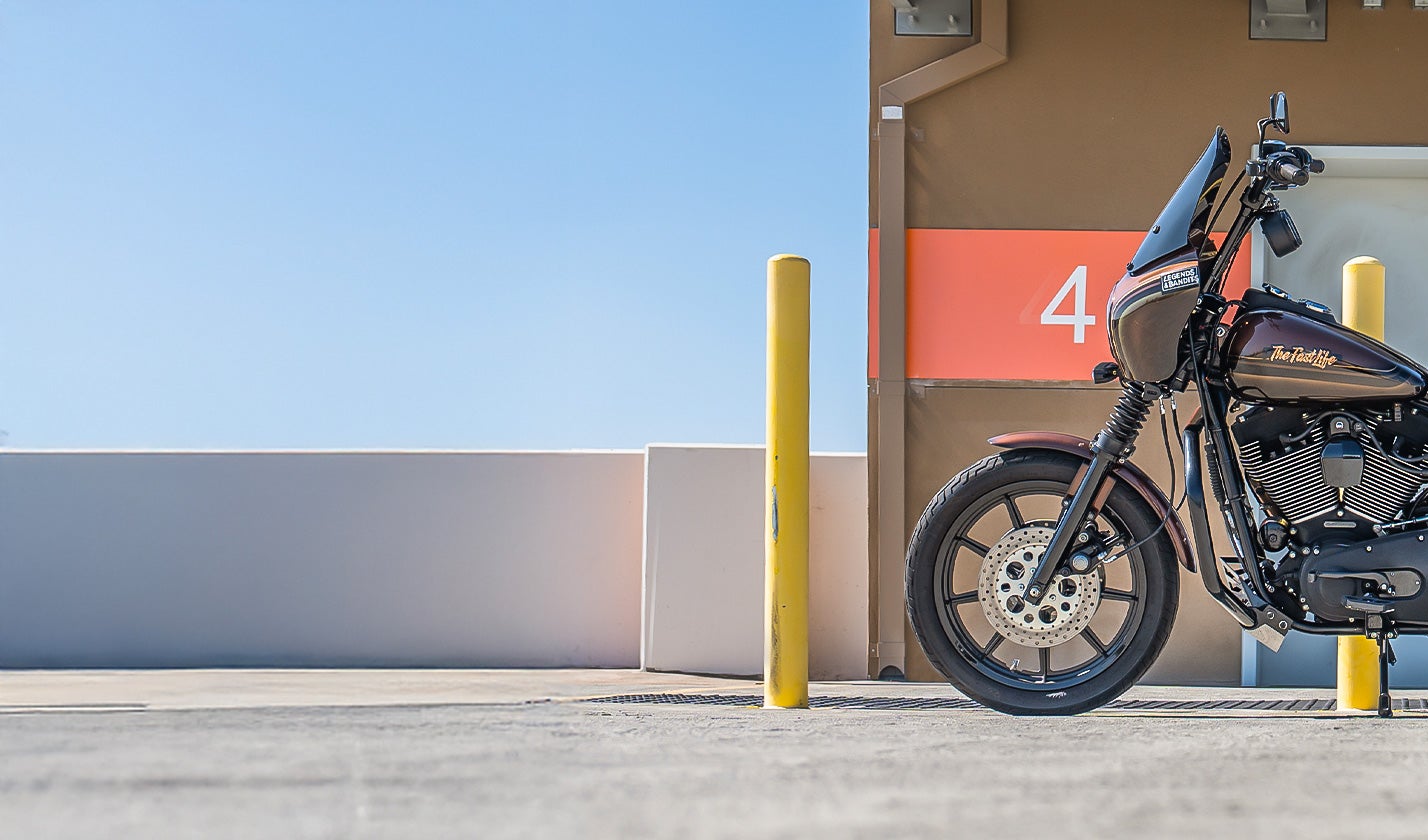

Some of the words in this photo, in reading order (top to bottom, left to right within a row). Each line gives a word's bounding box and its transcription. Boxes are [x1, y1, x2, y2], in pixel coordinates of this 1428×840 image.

[1163, 269, 1195, 282] LEGENDS
[1040, 265, 1096, 344] 4
[1270, 345, 1290, 361] The
[1289, 346, 1316, 363] Fast
[1312, 348, 1337, 369] Life
